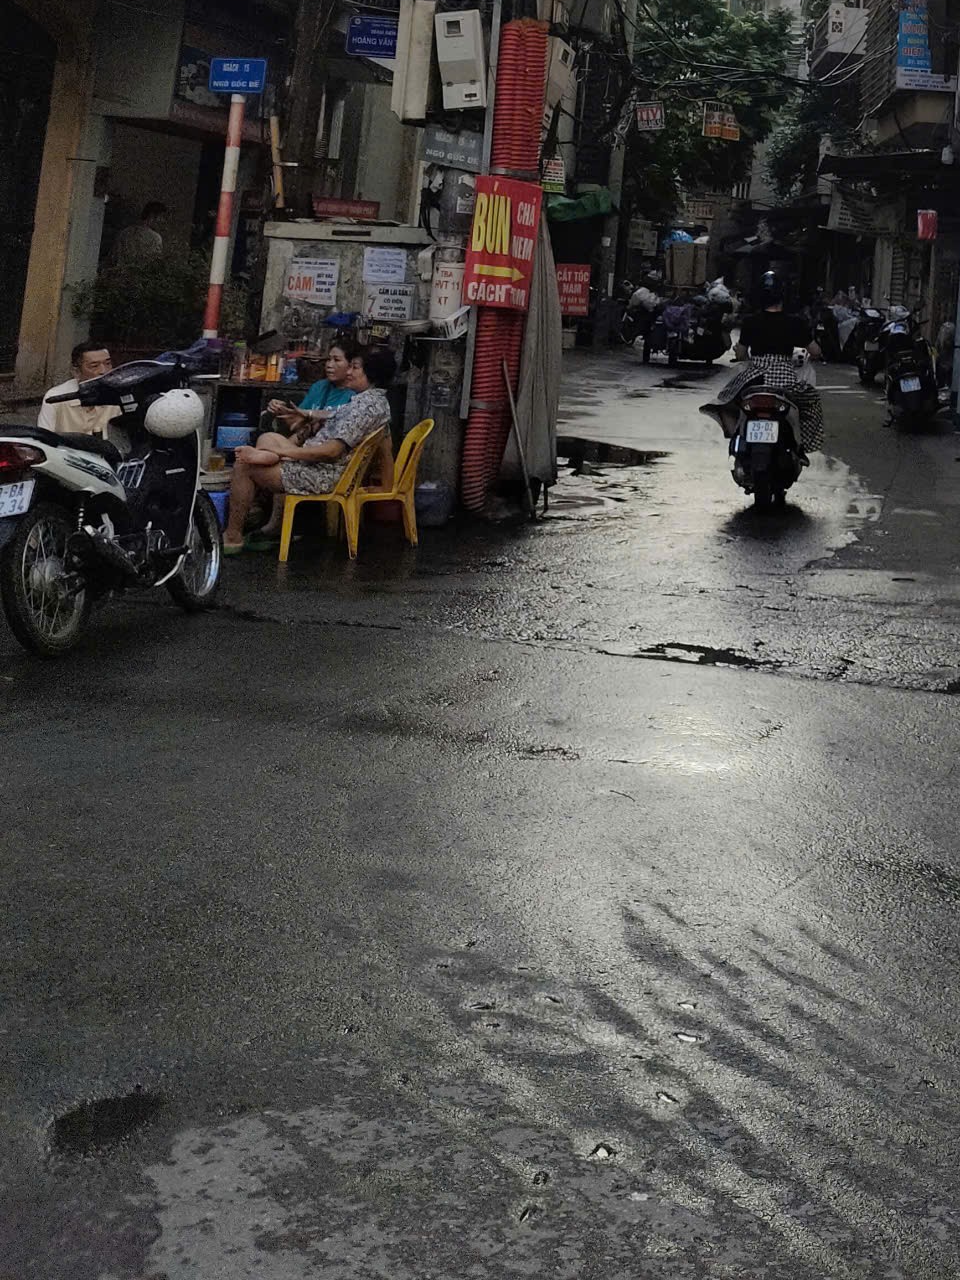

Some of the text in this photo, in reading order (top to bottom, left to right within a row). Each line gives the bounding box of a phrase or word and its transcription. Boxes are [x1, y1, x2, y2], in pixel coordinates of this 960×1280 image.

[472, 181, 511, 256] BÚN
[512, 235, 533, 261] NEM
[467, 279, 506, 302] CÁCH
